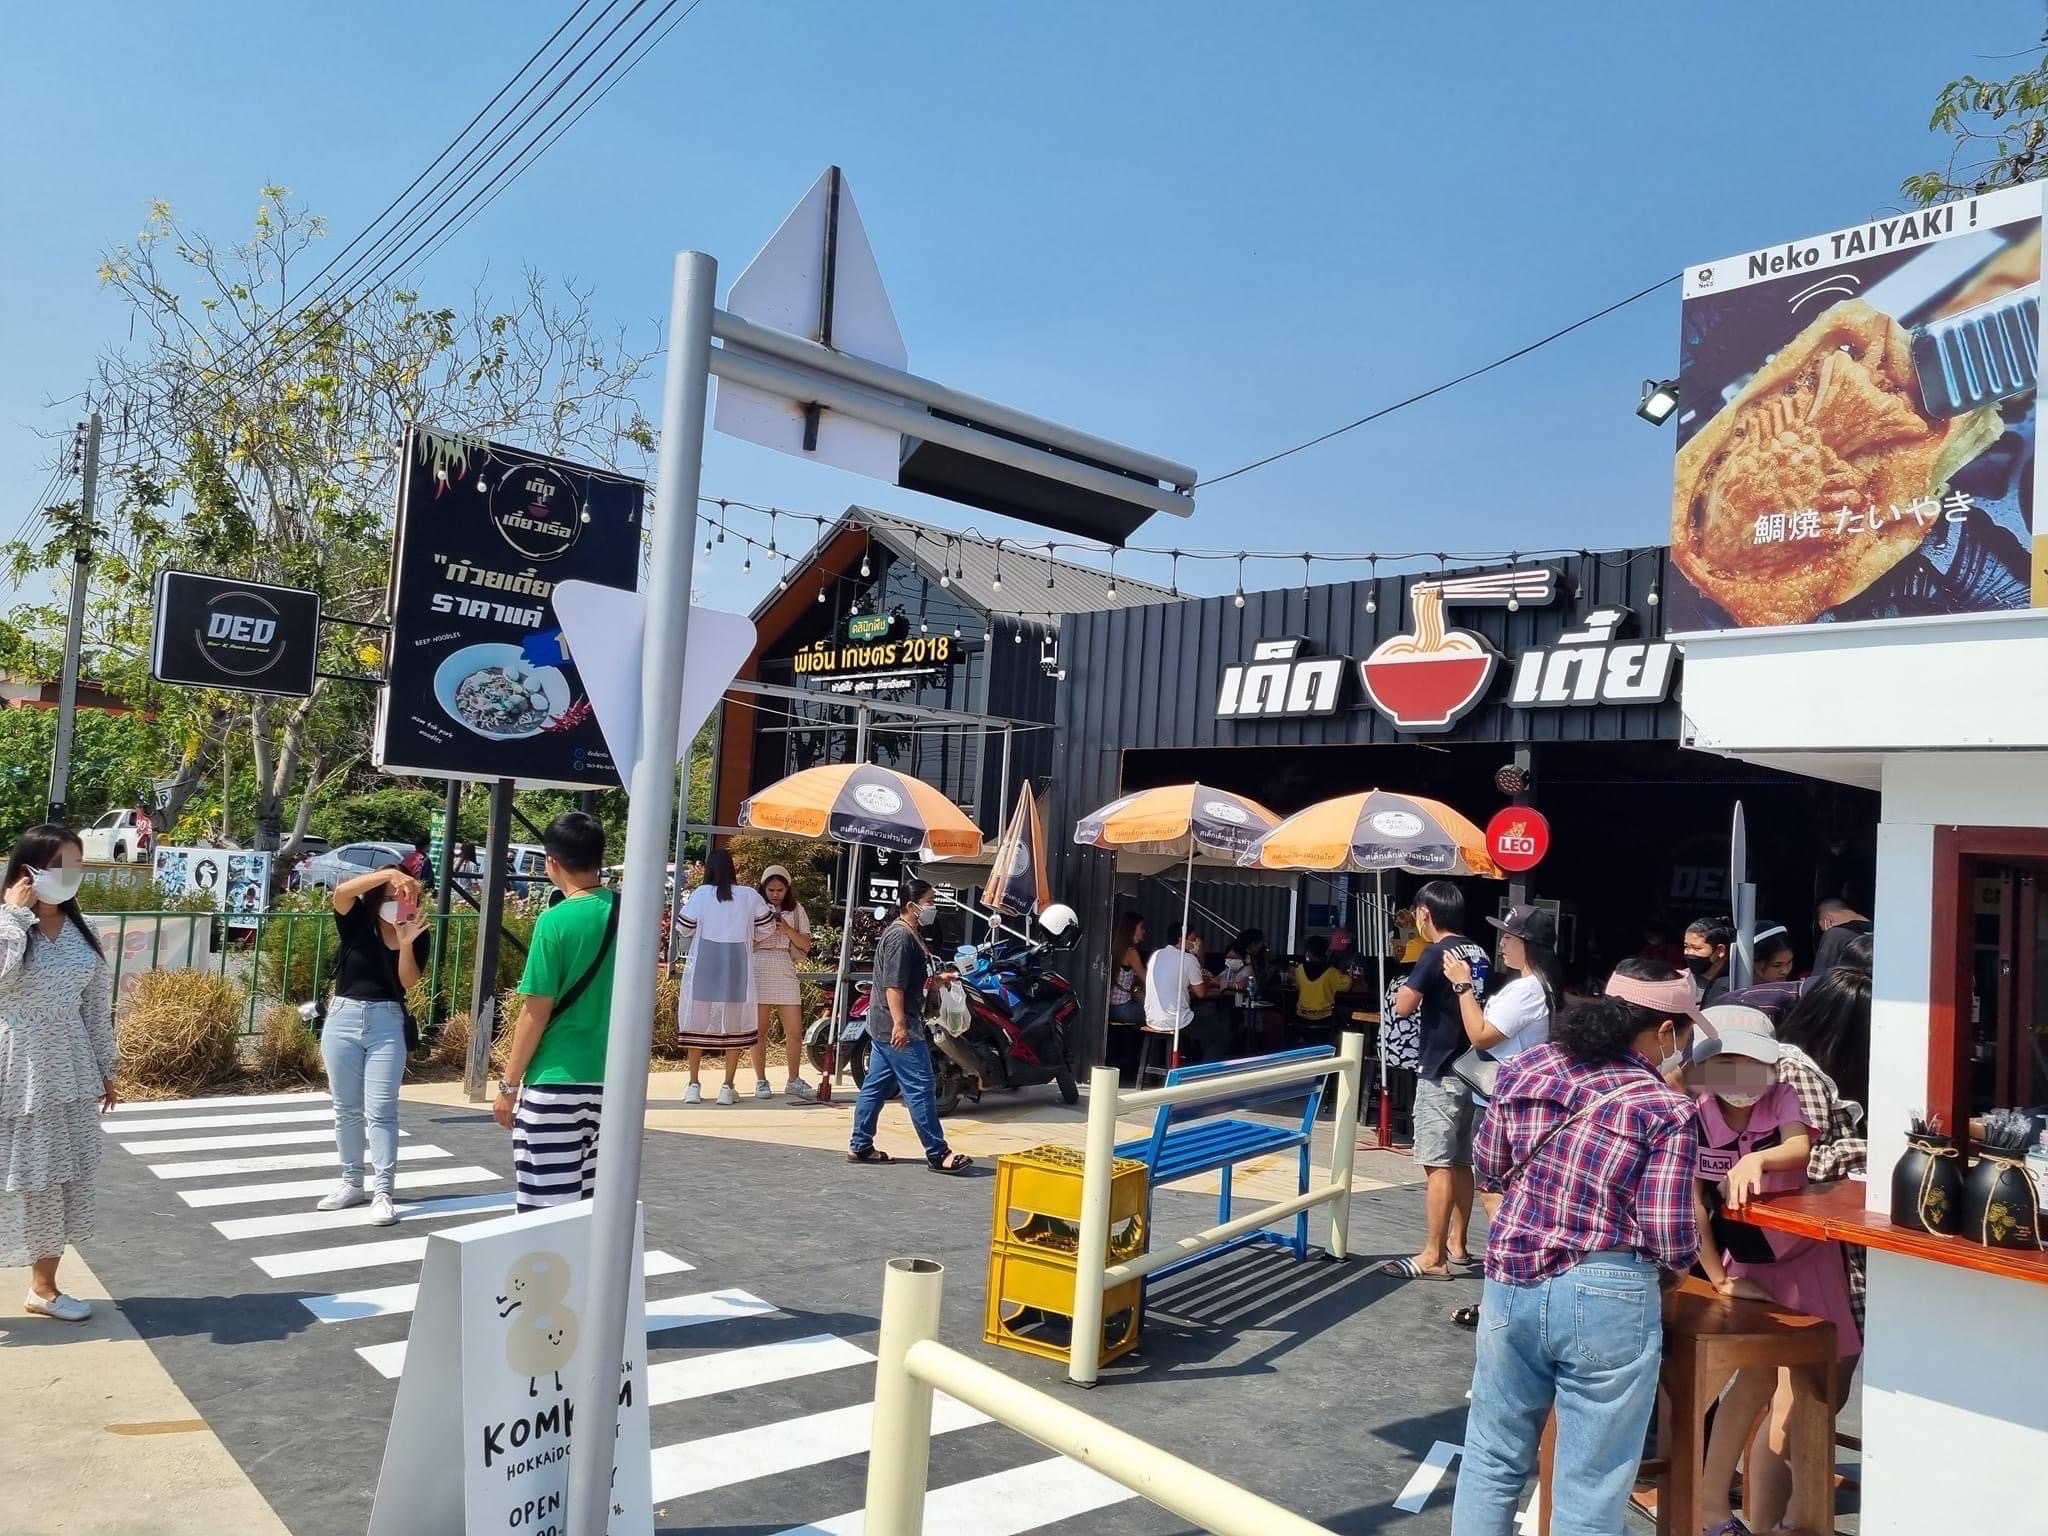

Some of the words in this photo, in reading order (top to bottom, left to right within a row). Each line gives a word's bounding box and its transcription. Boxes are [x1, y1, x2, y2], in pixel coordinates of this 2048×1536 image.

[1748, 244, 1819, 280] Neko
[1831, 205, 1954, 260] TAIYAKI
[1753, 508, 1821, 545] 鯛焼
[1834, 490, 1975, 535] たいやき
[434, 553, 557, 598] "ก๋วยเตี๋ย
[208, 612, 276, 645] DED
[431, 593, 544, 628] ราคาแค่
[794, 640, 835, 673] พีเอ็น
[841, 643, 897, 669] เกษตร
[902, 636, 949, 664] 2018
[1512, 609, 1680, 704] เตี๋ย
[1216, 638, 1343, 716] เด็ด
[1501, 838, 1532, 853] LEO
[1702, 1159, 1730, 1171] BLACK
[509, 1490, 560, 1528] OPEN
